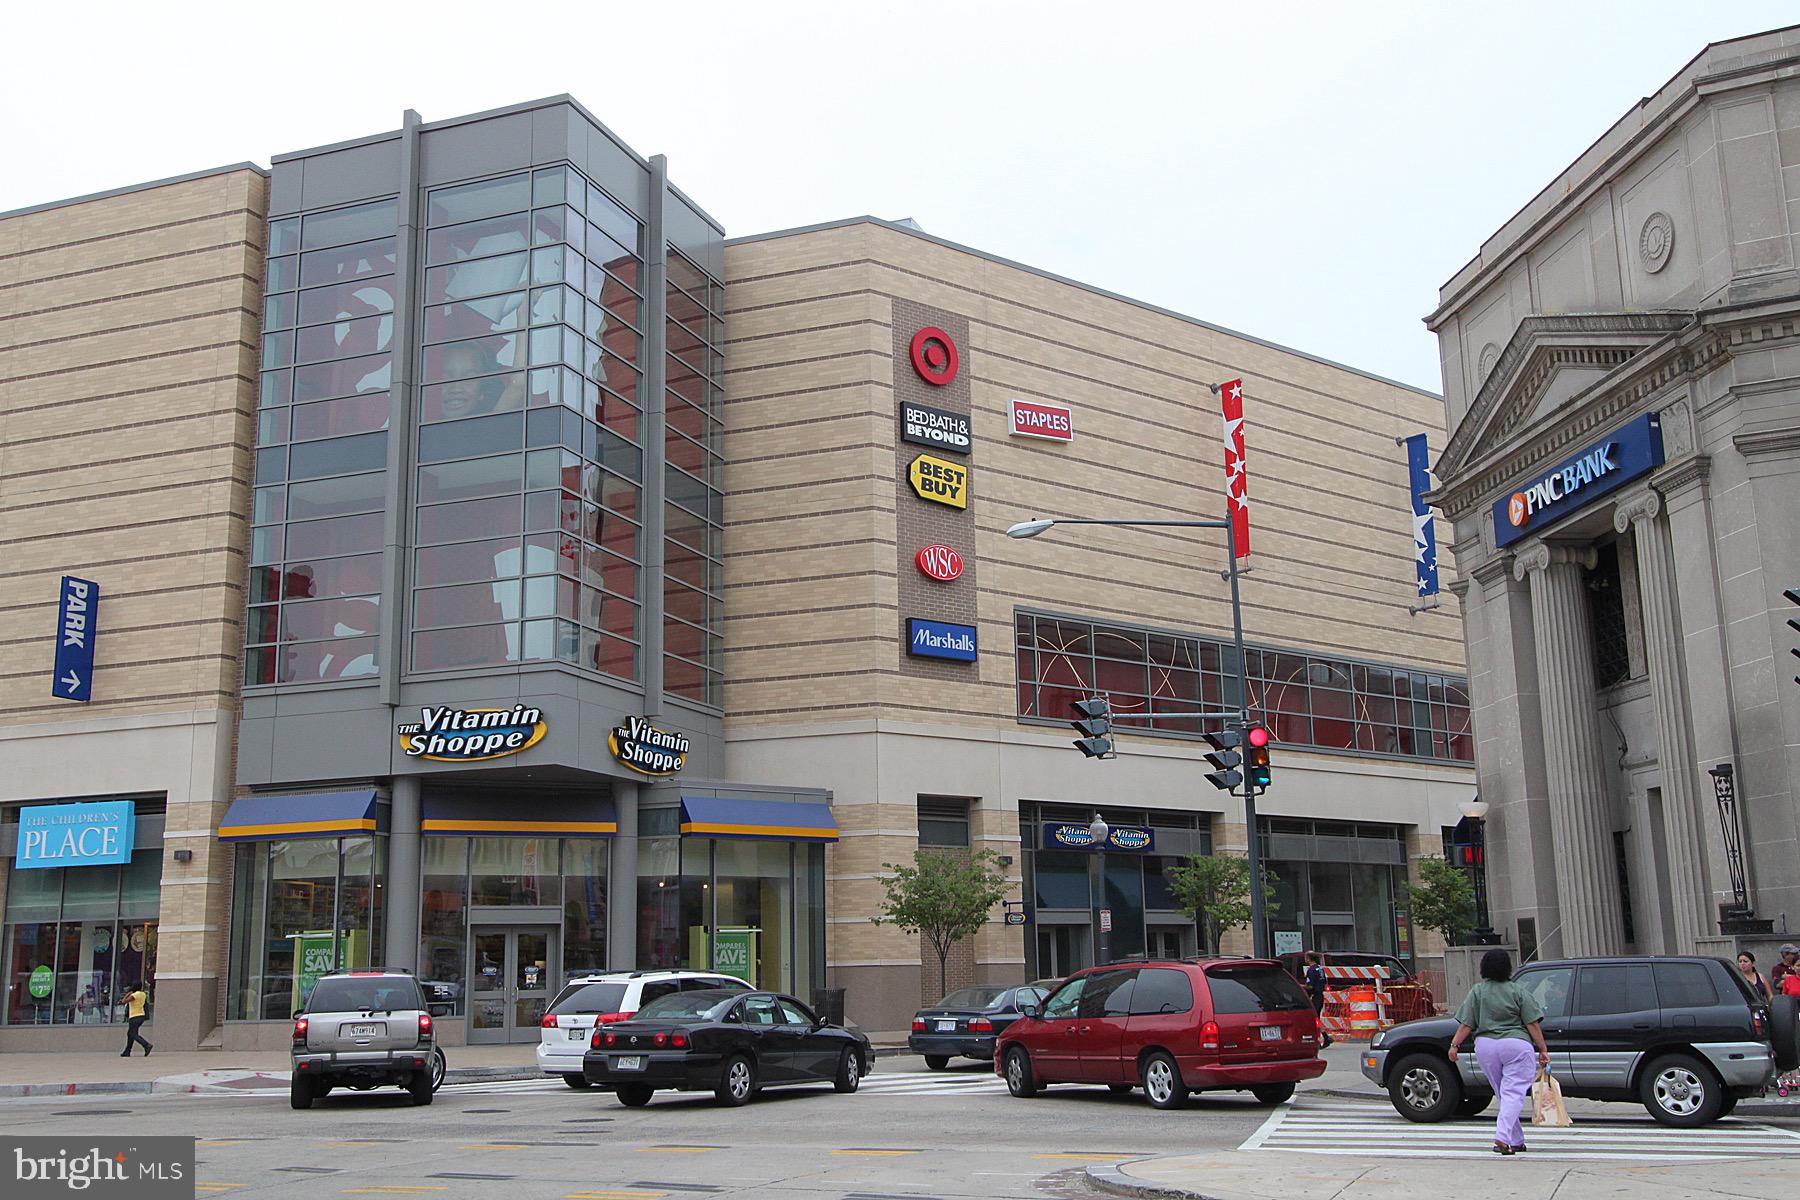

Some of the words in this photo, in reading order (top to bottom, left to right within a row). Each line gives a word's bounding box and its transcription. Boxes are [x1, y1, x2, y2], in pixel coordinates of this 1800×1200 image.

[906, 407, 929, 425] BED
[929, 413, 958, 433] BATH
[958, 420, 969, 436] &
[1016, 409, 1069, 431] STAPLES
[907, 422, 970, 446] BEYOND
[919, 460, 965, 485] BEST
[1524, 473, 1564, 515] PNC
[1561, 442, 1616, 495] BANK
[921, 477, 961, 499] BUY
[925, 547, 958, 577] WSC
[63, 580, 89, 649] PARK
[913, 629, 976, 652] Marshalls
[398, 724, 421, 734] THE
[422, 705, 540, 732] Vitamin
[406, 731, 524, 755] Shoppe
[618, 728, 631, 738] THE
[630, 716, 690, 753] Vitamin
[622, 741, 682, 771] Shoppe
[27, 815, 48, 827] THE
[51, 812, 119, 826] CHILDREN'S
[1061, 825, 1091, 835] Vitami
[23, 826, 119, 860] PLACE
[1060, 835, 1092, 844] Shoppe
[1115, 838, 1145, 847] Shoppe
[1116, 828, 1149, 839] Vitamin
[715, 949, 747, 964] AVE
